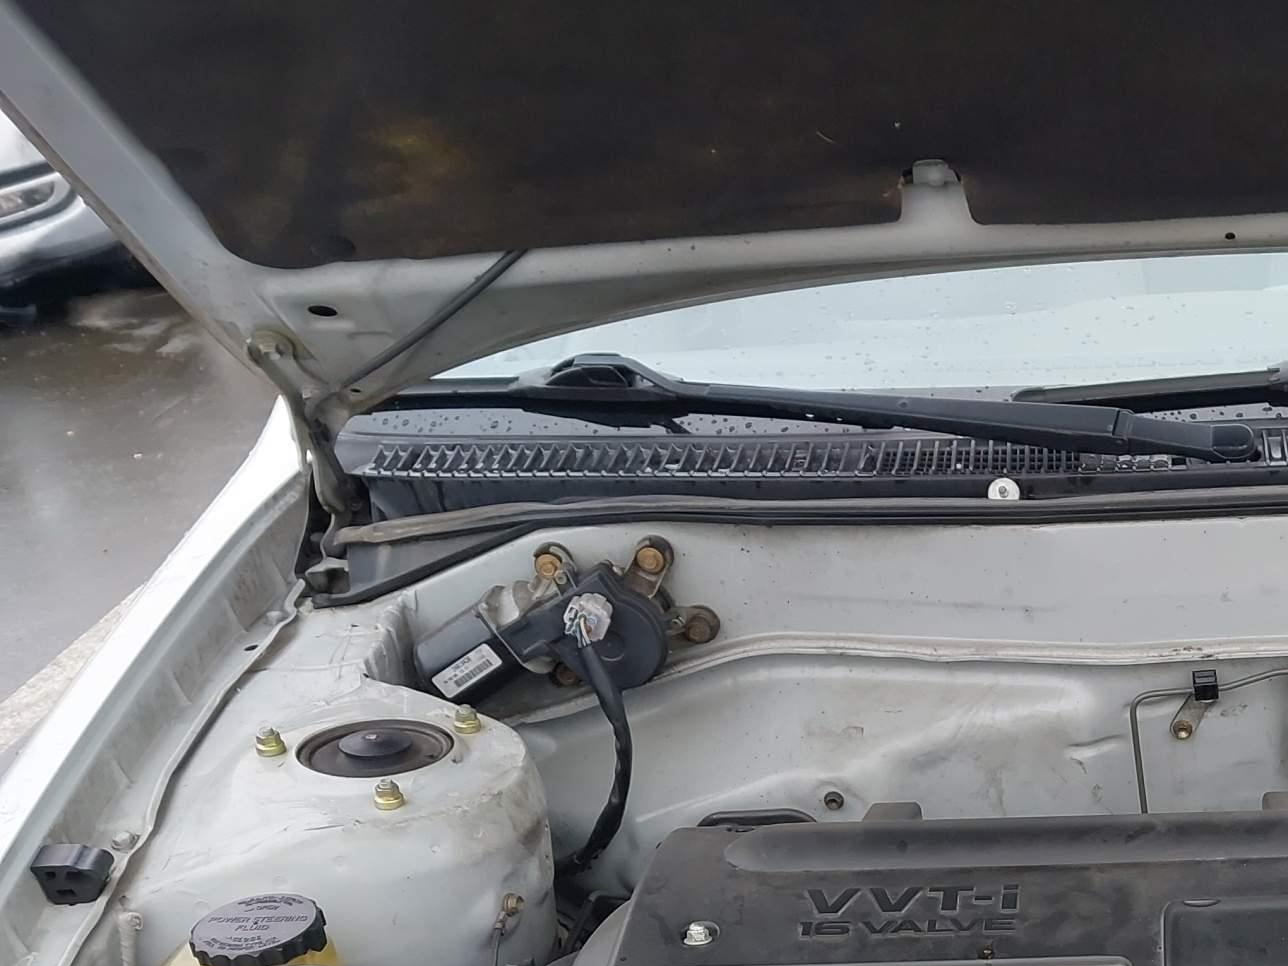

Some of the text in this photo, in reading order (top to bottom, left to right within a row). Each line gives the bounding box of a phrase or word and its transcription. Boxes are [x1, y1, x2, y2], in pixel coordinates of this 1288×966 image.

[807, 884, 1019, 914] VVT-i
[253, 915, 309, 923] STEERING
[234, 924, 270, 932] FLUID
[800, 917, 1017, 936] 16 VALVE
